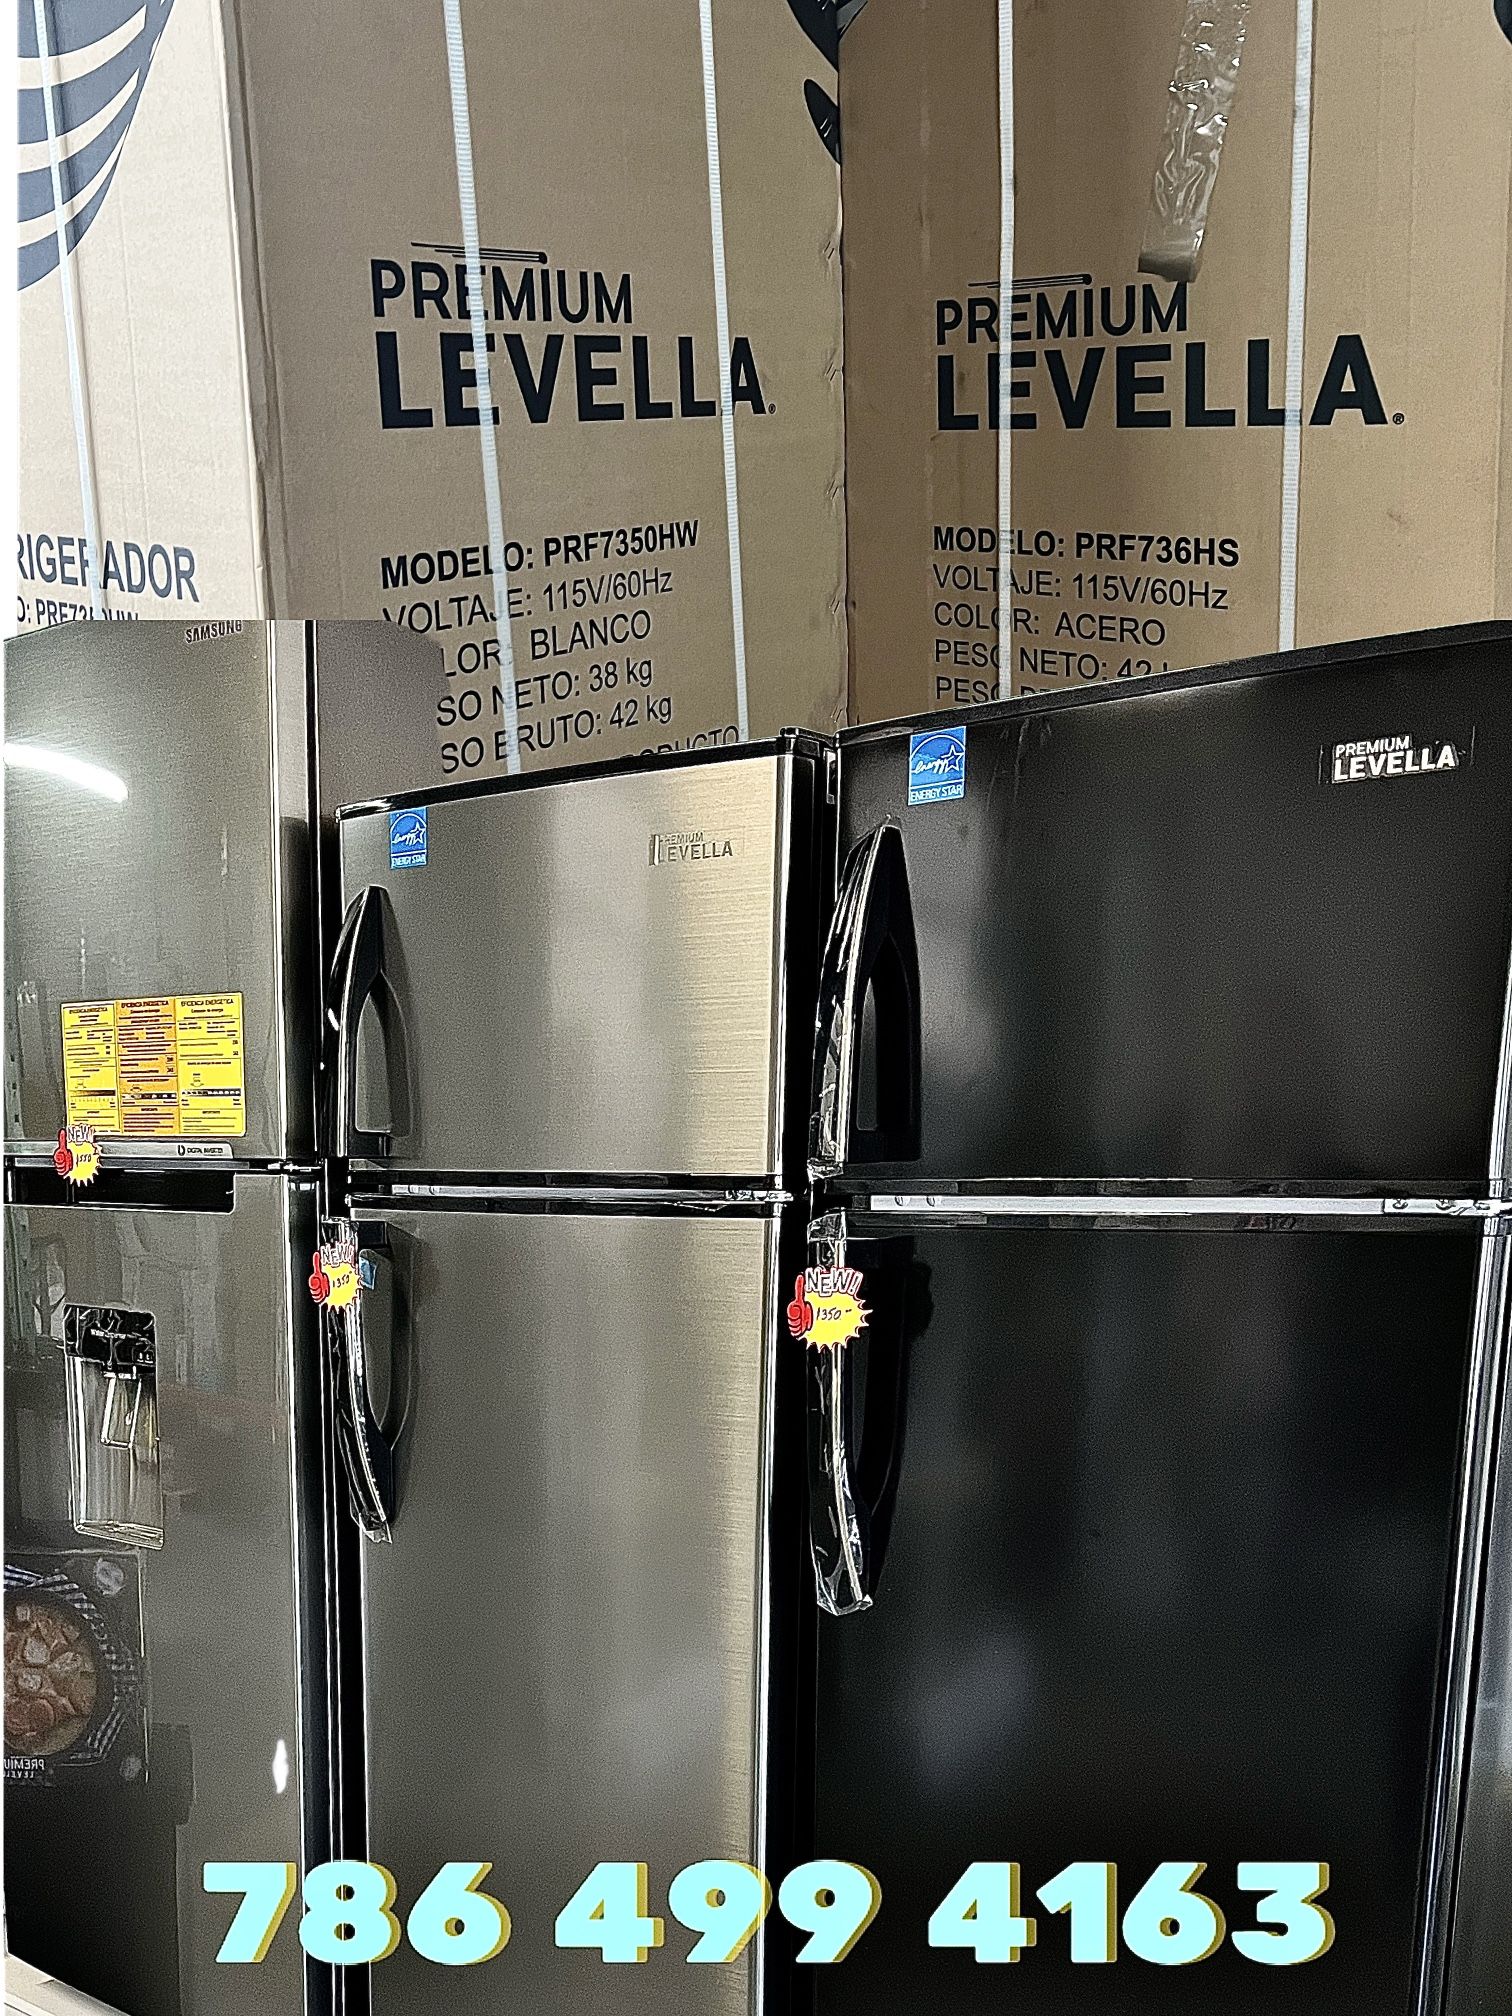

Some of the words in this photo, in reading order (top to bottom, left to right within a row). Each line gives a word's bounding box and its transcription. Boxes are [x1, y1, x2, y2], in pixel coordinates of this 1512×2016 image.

[371, 258, 632, 324] PREMIUM
[936, 281, 1187, 345] PREMIUM
[380, 542, 533, 589] MODELO:
[543, 520, 699, 567] PRF7350HW
[1075, 532, 1239, 567] PRF736HS
[382, 587, 533, 634] VOLTAE:
[543, 567, 673, 611] 115V/60Hz
[1072, 573, 1229, 610] 115V/60Hz
[185, 620, 242, 644] SAMSUNG
[530, 609, 651, 660] BLANCO
[934, 602, 1039, 634] COLOR:
[1055, 612, 1166, 646] ACERO
[588, 664, 618, 693] 38
[626, 658, 652, 687] kg
[1019, 647, 1108, 681] NETO:
[609, 699, 639, 729] 42
[646, 695, 672, 724] kg
[1333, 744, 1457, 782] LEVELLA
[1335, 735, 1410, 758] PREMIUM
